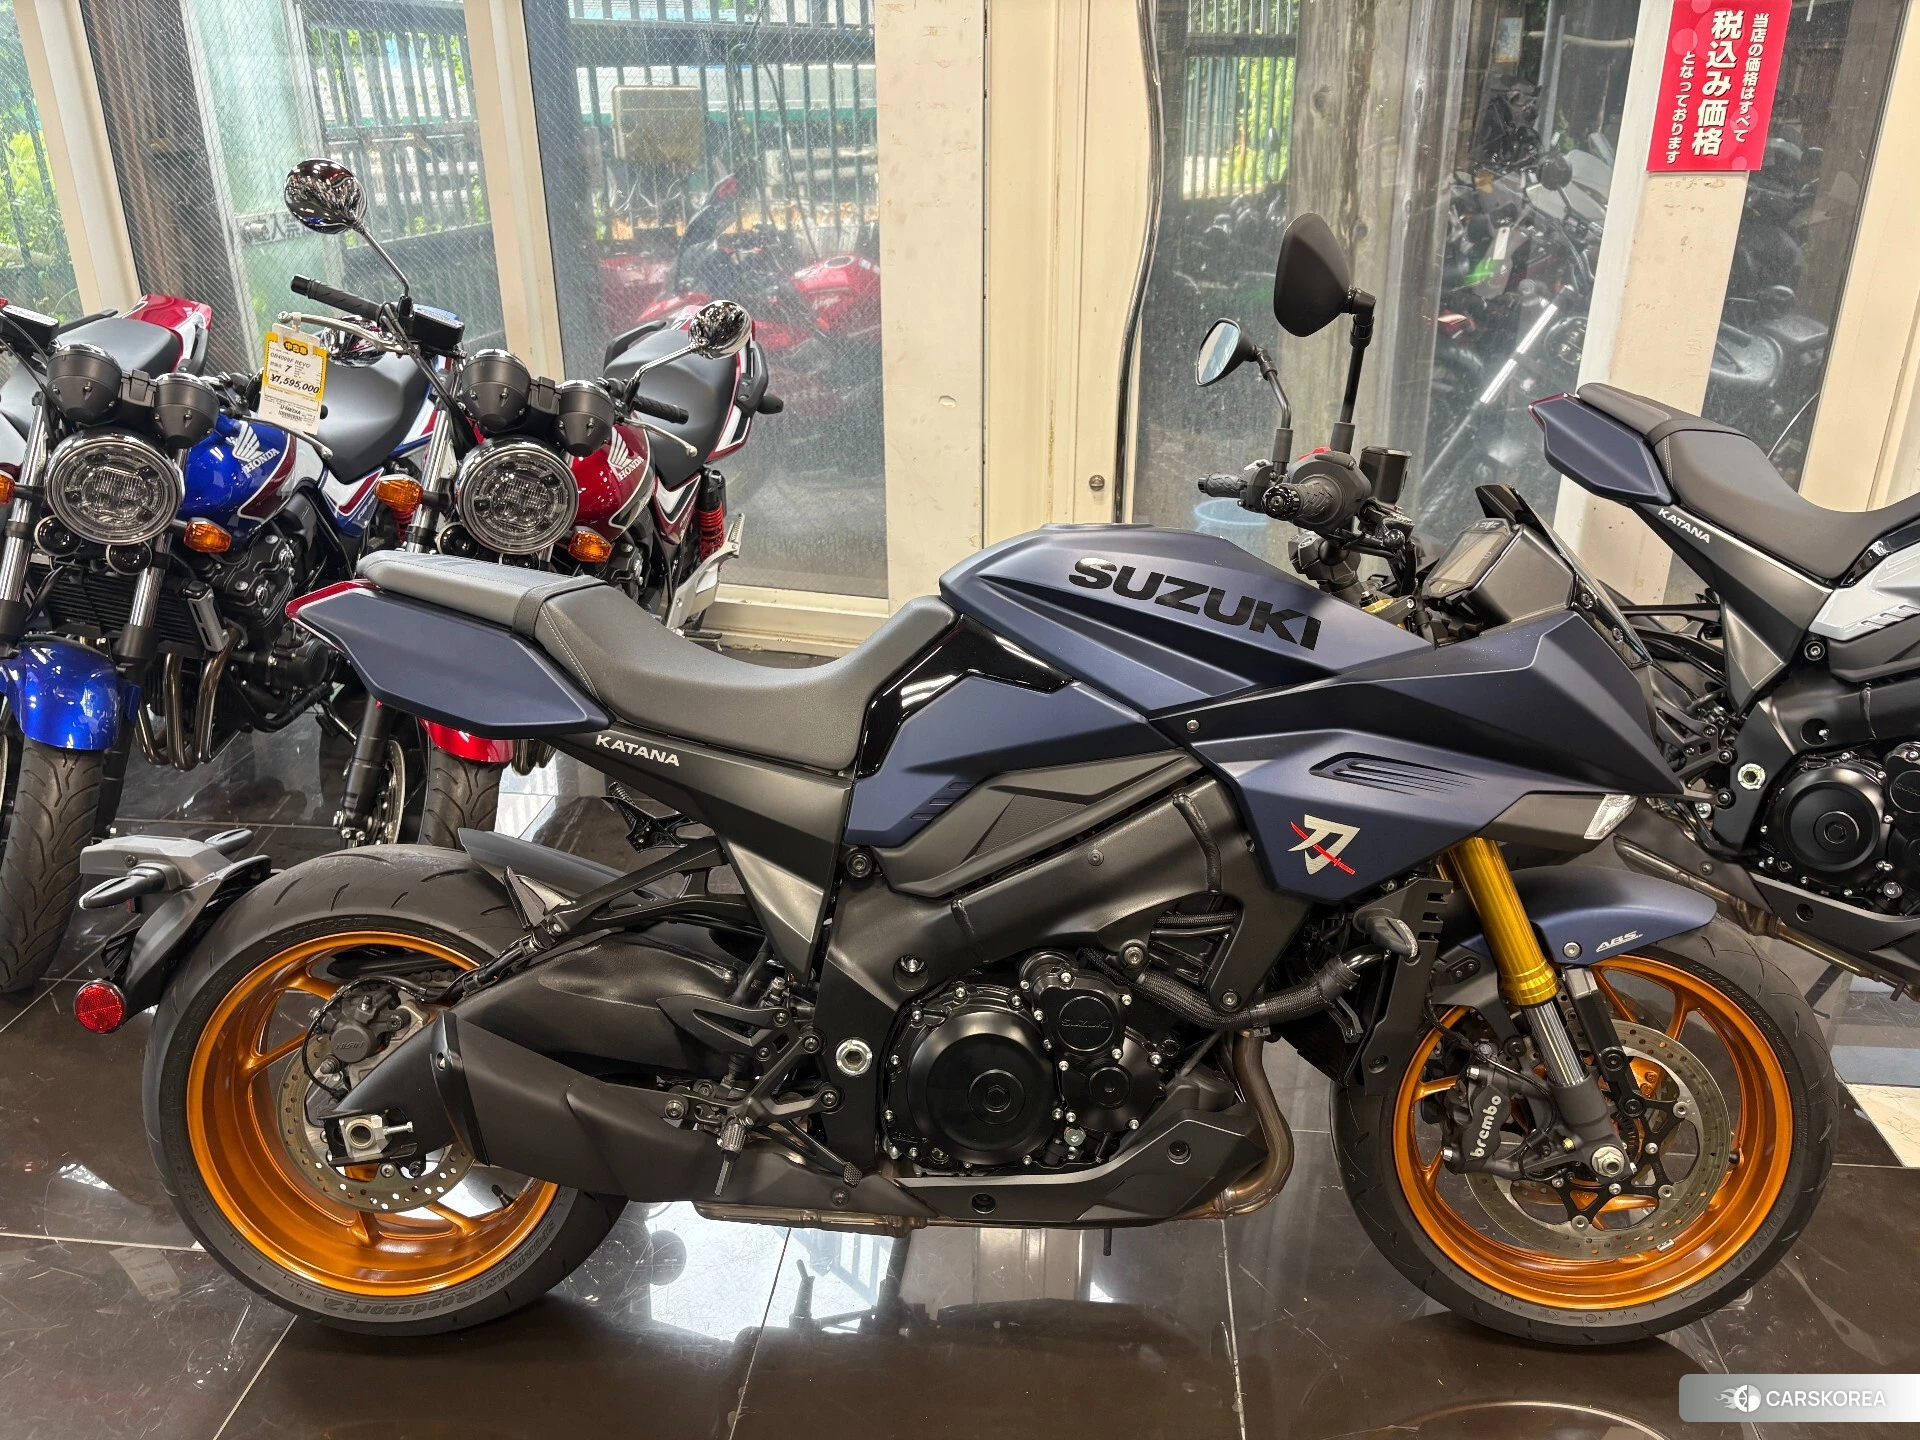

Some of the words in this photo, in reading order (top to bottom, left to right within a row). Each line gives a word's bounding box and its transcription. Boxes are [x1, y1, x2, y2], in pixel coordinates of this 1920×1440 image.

[1691, 9, 1745, 156] 税込み価格
[1733, 12, 1769, 143] 当店の価格はすべて
[1665, 50, 1696, 165] となっております
[270, 372, 320, 395] ¥1,595,000
[284, 364, 292, 373] 7
[242, 447, 281, 479] HONDA
[617, 455, 645, 481] HONDA
[1657, 507, 1711, 544] KATANA
[1068, 557, 1322, 651] SUZUKI
[595, 734, 680, 767] KATANA
[1595, 930, 1640, 953] ABS
[1469, 1095, 1502, 1158] brembo
